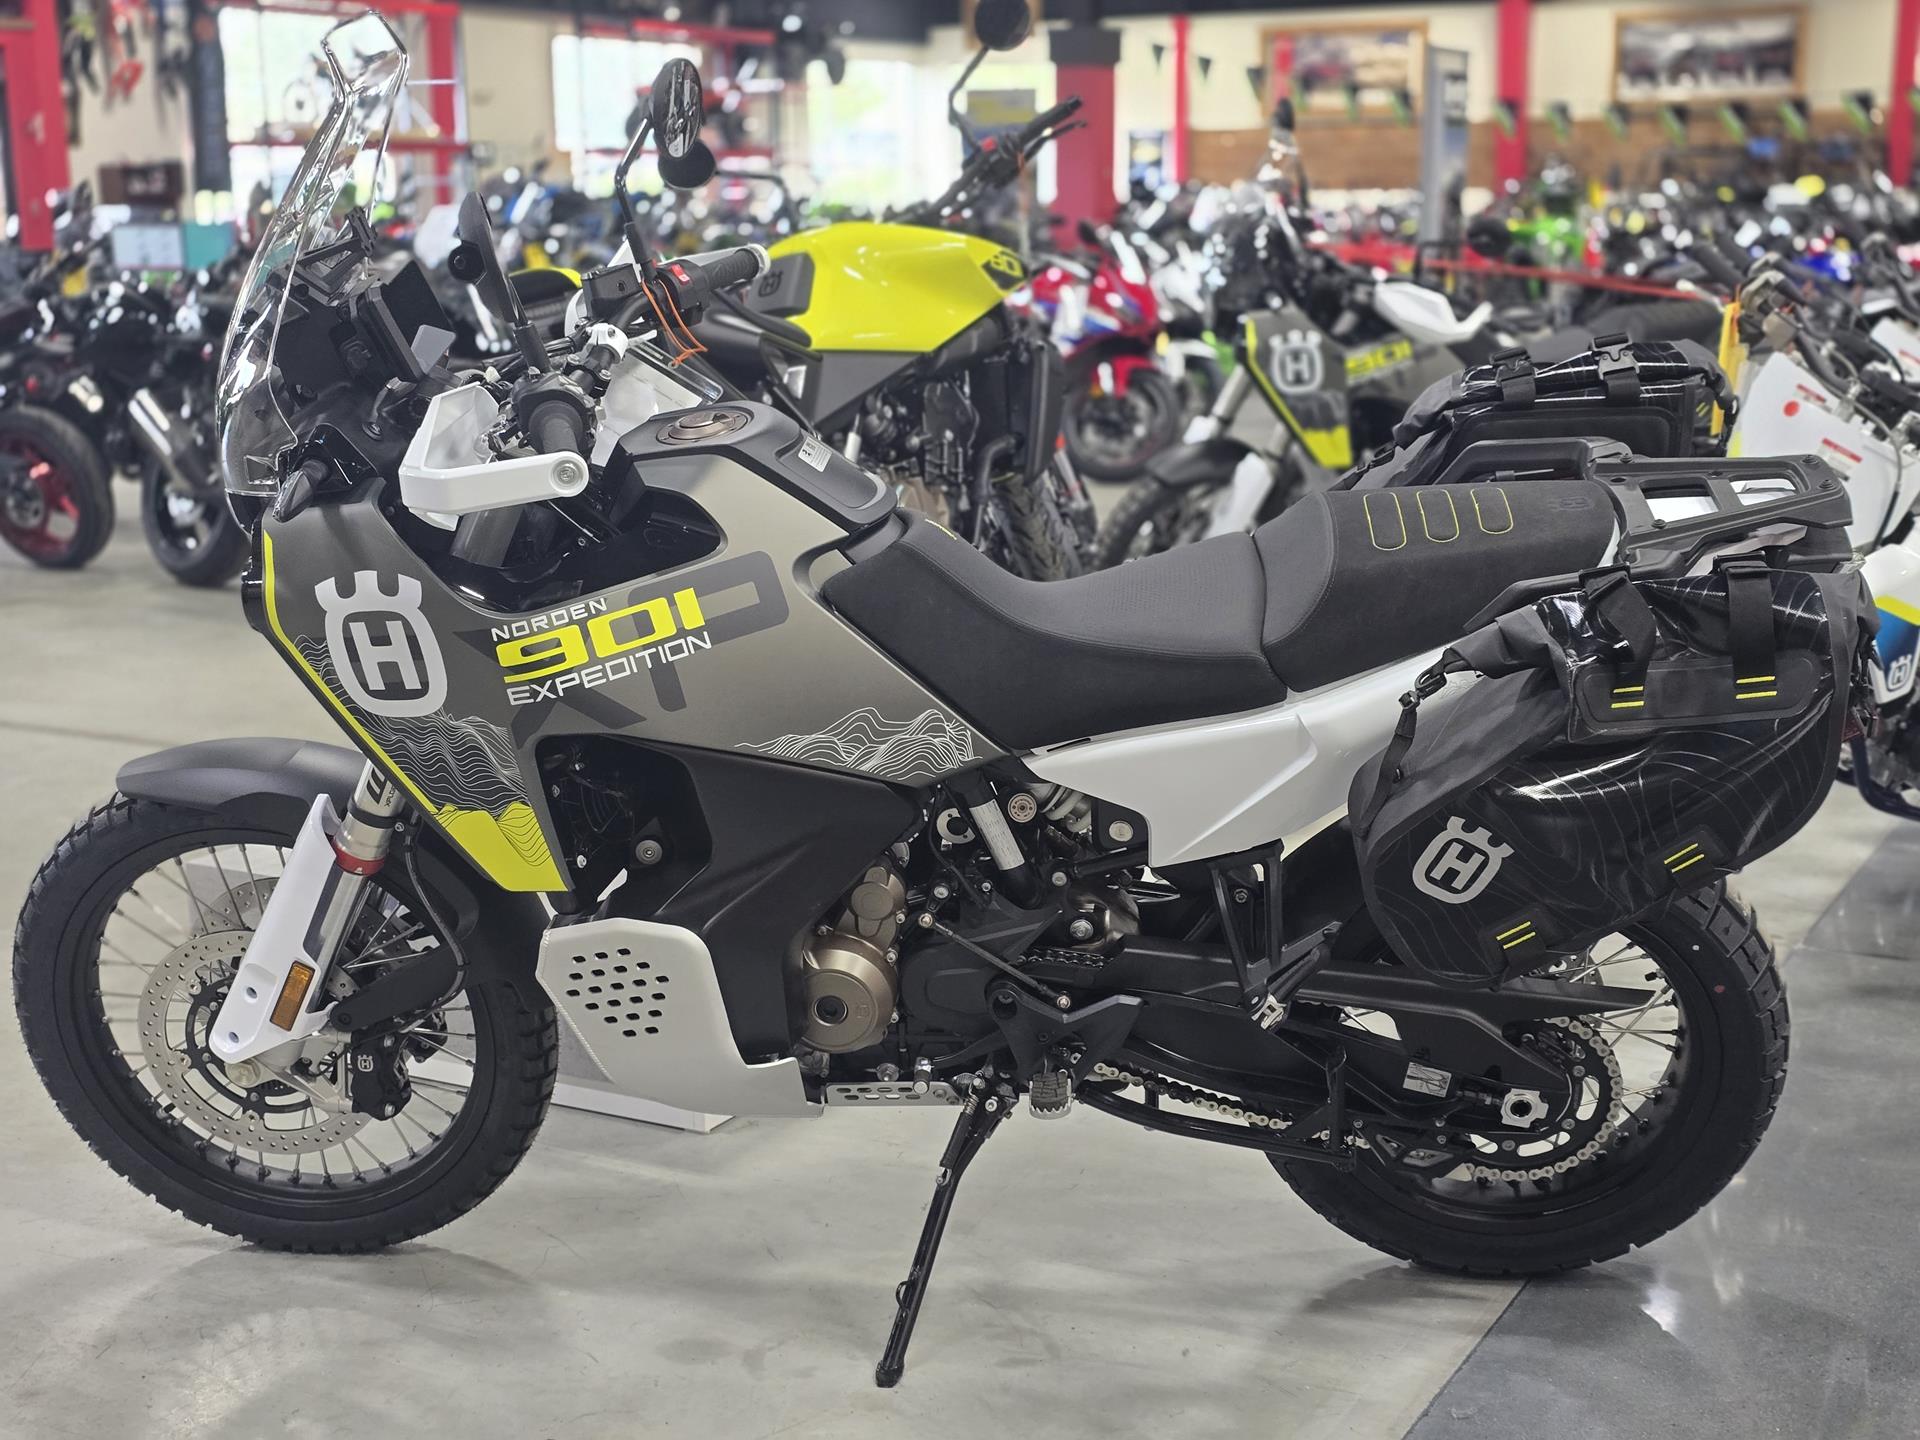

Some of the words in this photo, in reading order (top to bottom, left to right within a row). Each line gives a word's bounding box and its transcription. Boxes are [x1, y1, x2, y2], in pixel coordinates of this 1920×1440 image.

[491, 597, 608, 642] NORDEN
[496, 587, 706, 684] 901
[506, 631, 713, 707] EXPEDITION
